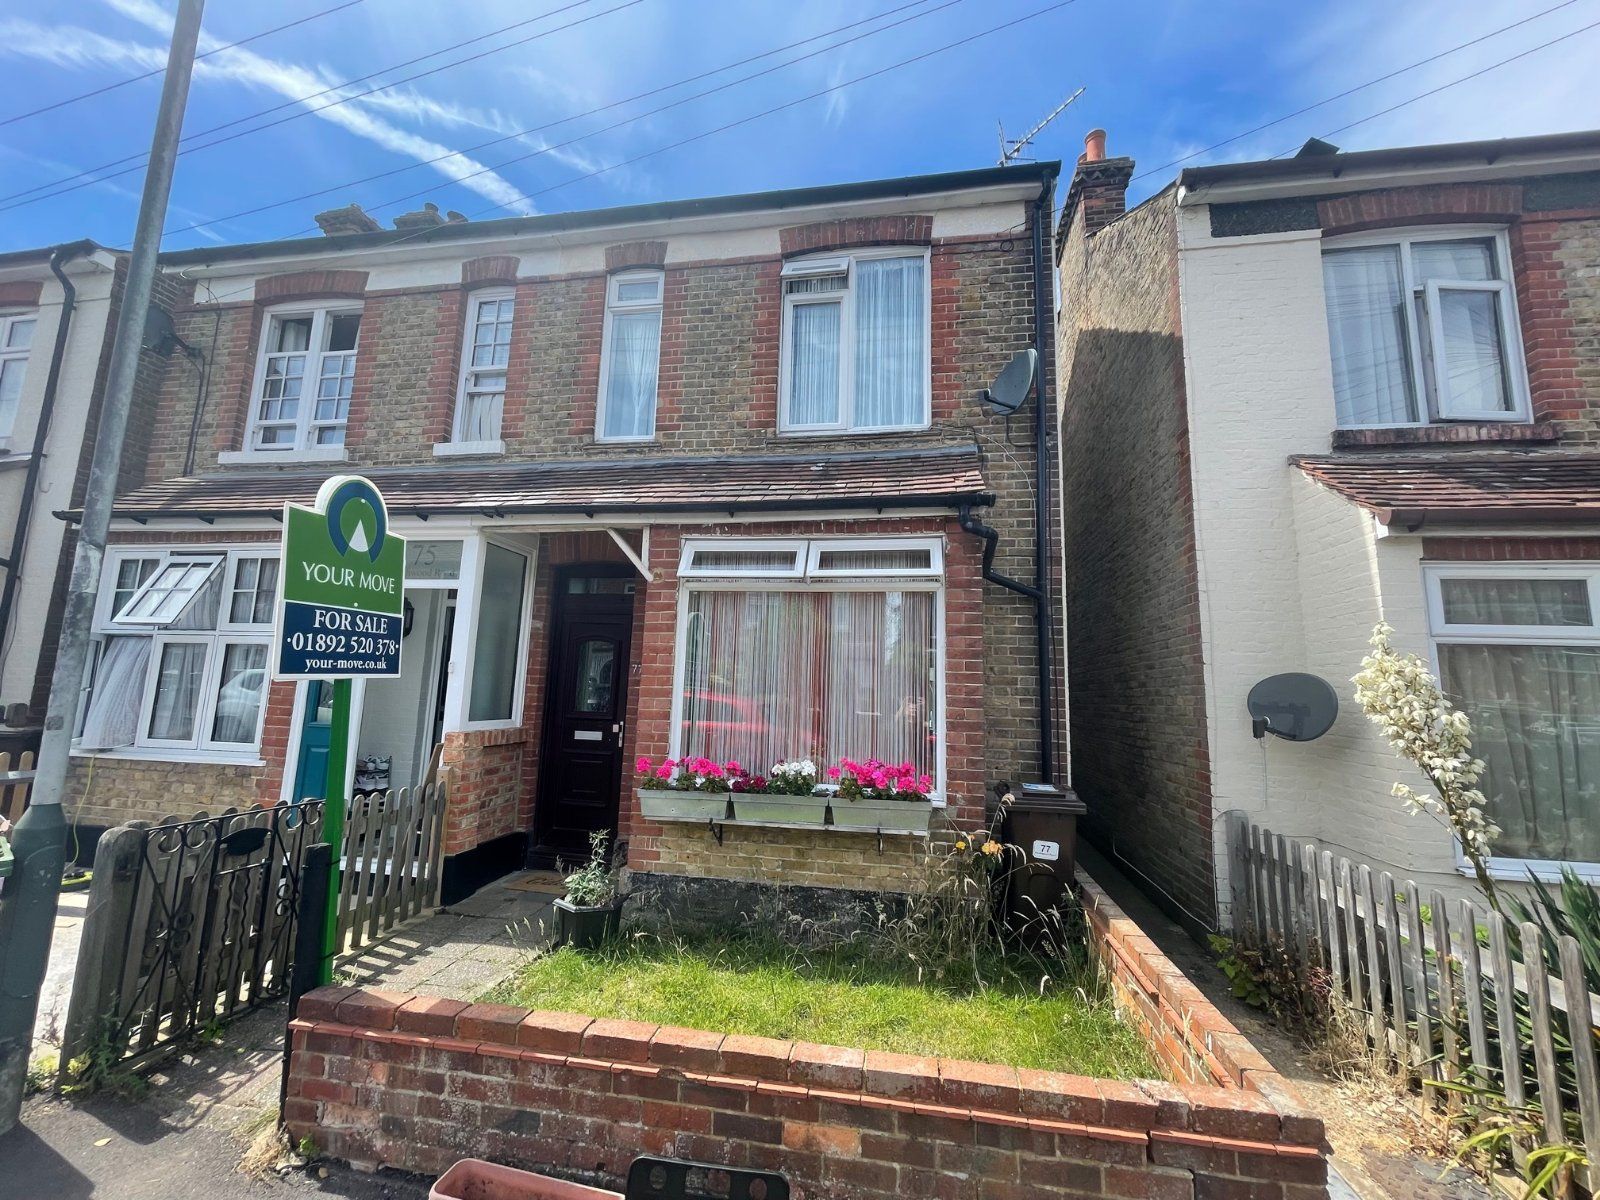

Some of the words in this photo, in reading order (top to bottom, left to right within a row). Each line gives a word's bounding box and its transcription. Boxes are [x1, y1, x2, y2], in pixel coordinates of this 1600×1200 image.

[412, 544, 440, 566] 75
[303, 561, 355, 587] YOUR
[359, 571, 395, 595] MOVE
[313, 609, 352, 631] FOR
[355, 614, 388, 635] SALE
[291, 632, 346, 654] 01892
[349, 636, 374, 654] 520
[375, 638, 395, 656] 378
[304, 656, 387, 673] your-move.co.uk
[1041, 845, 1051, 853] 77
